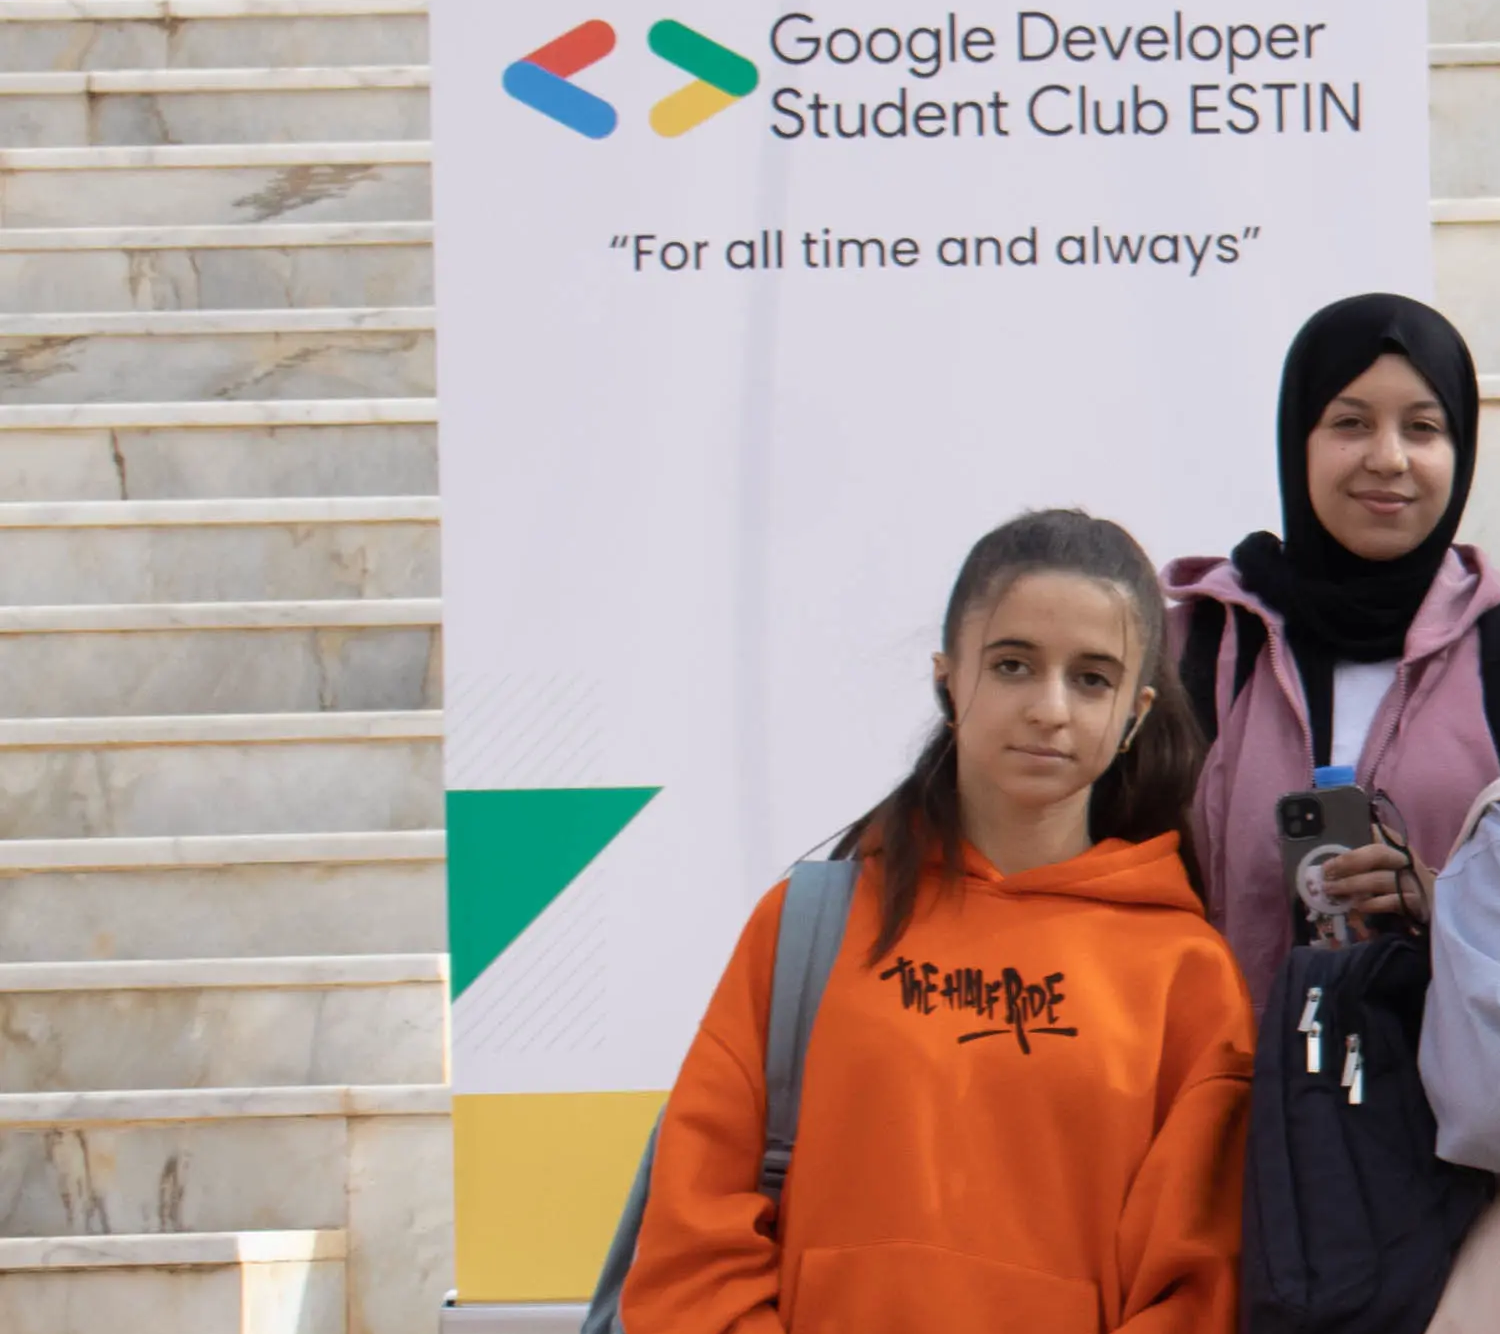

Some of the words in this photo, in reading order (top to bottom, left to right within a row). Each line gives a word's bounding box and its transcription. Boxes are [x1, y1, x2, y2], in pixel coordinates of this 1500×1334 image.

[769, 12, 996, 79] Google
[1017, 10, 1326, 75] Developer
[770, 87, 1009, 140] Student
[1027, 84, 1169, 137] Club
[1190, 82, 1361, 135] ESTIN
[725, 229, 783, 270] all
[801, 227, 920, 269] time
[936, 226, 1038, 267] and
